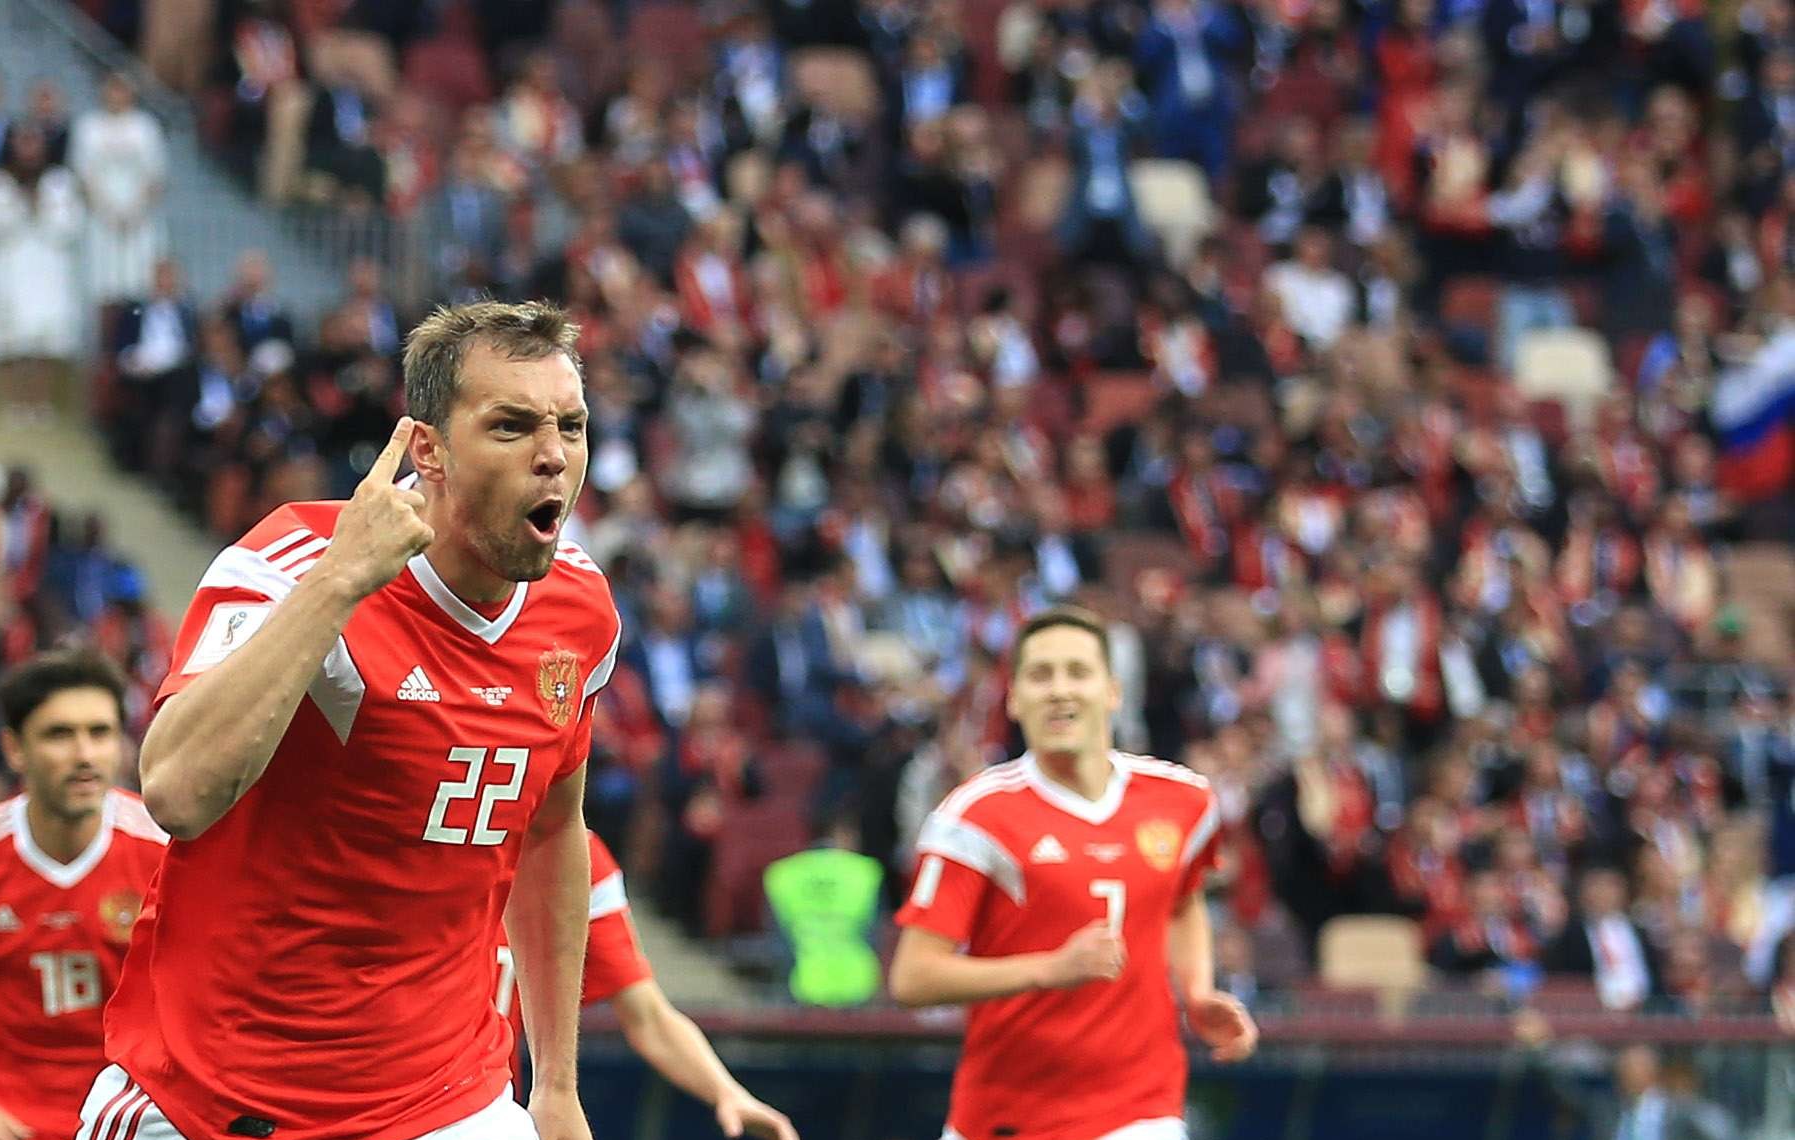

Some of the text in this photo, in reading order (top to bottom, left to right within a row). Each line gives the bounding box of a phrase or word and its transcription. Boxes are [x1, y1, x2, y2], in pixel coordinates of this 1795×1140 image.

[396, 686, 442, 702] adidas
[422, 746, 530, 847] 22
[29, 952, 102, 1017] 18
